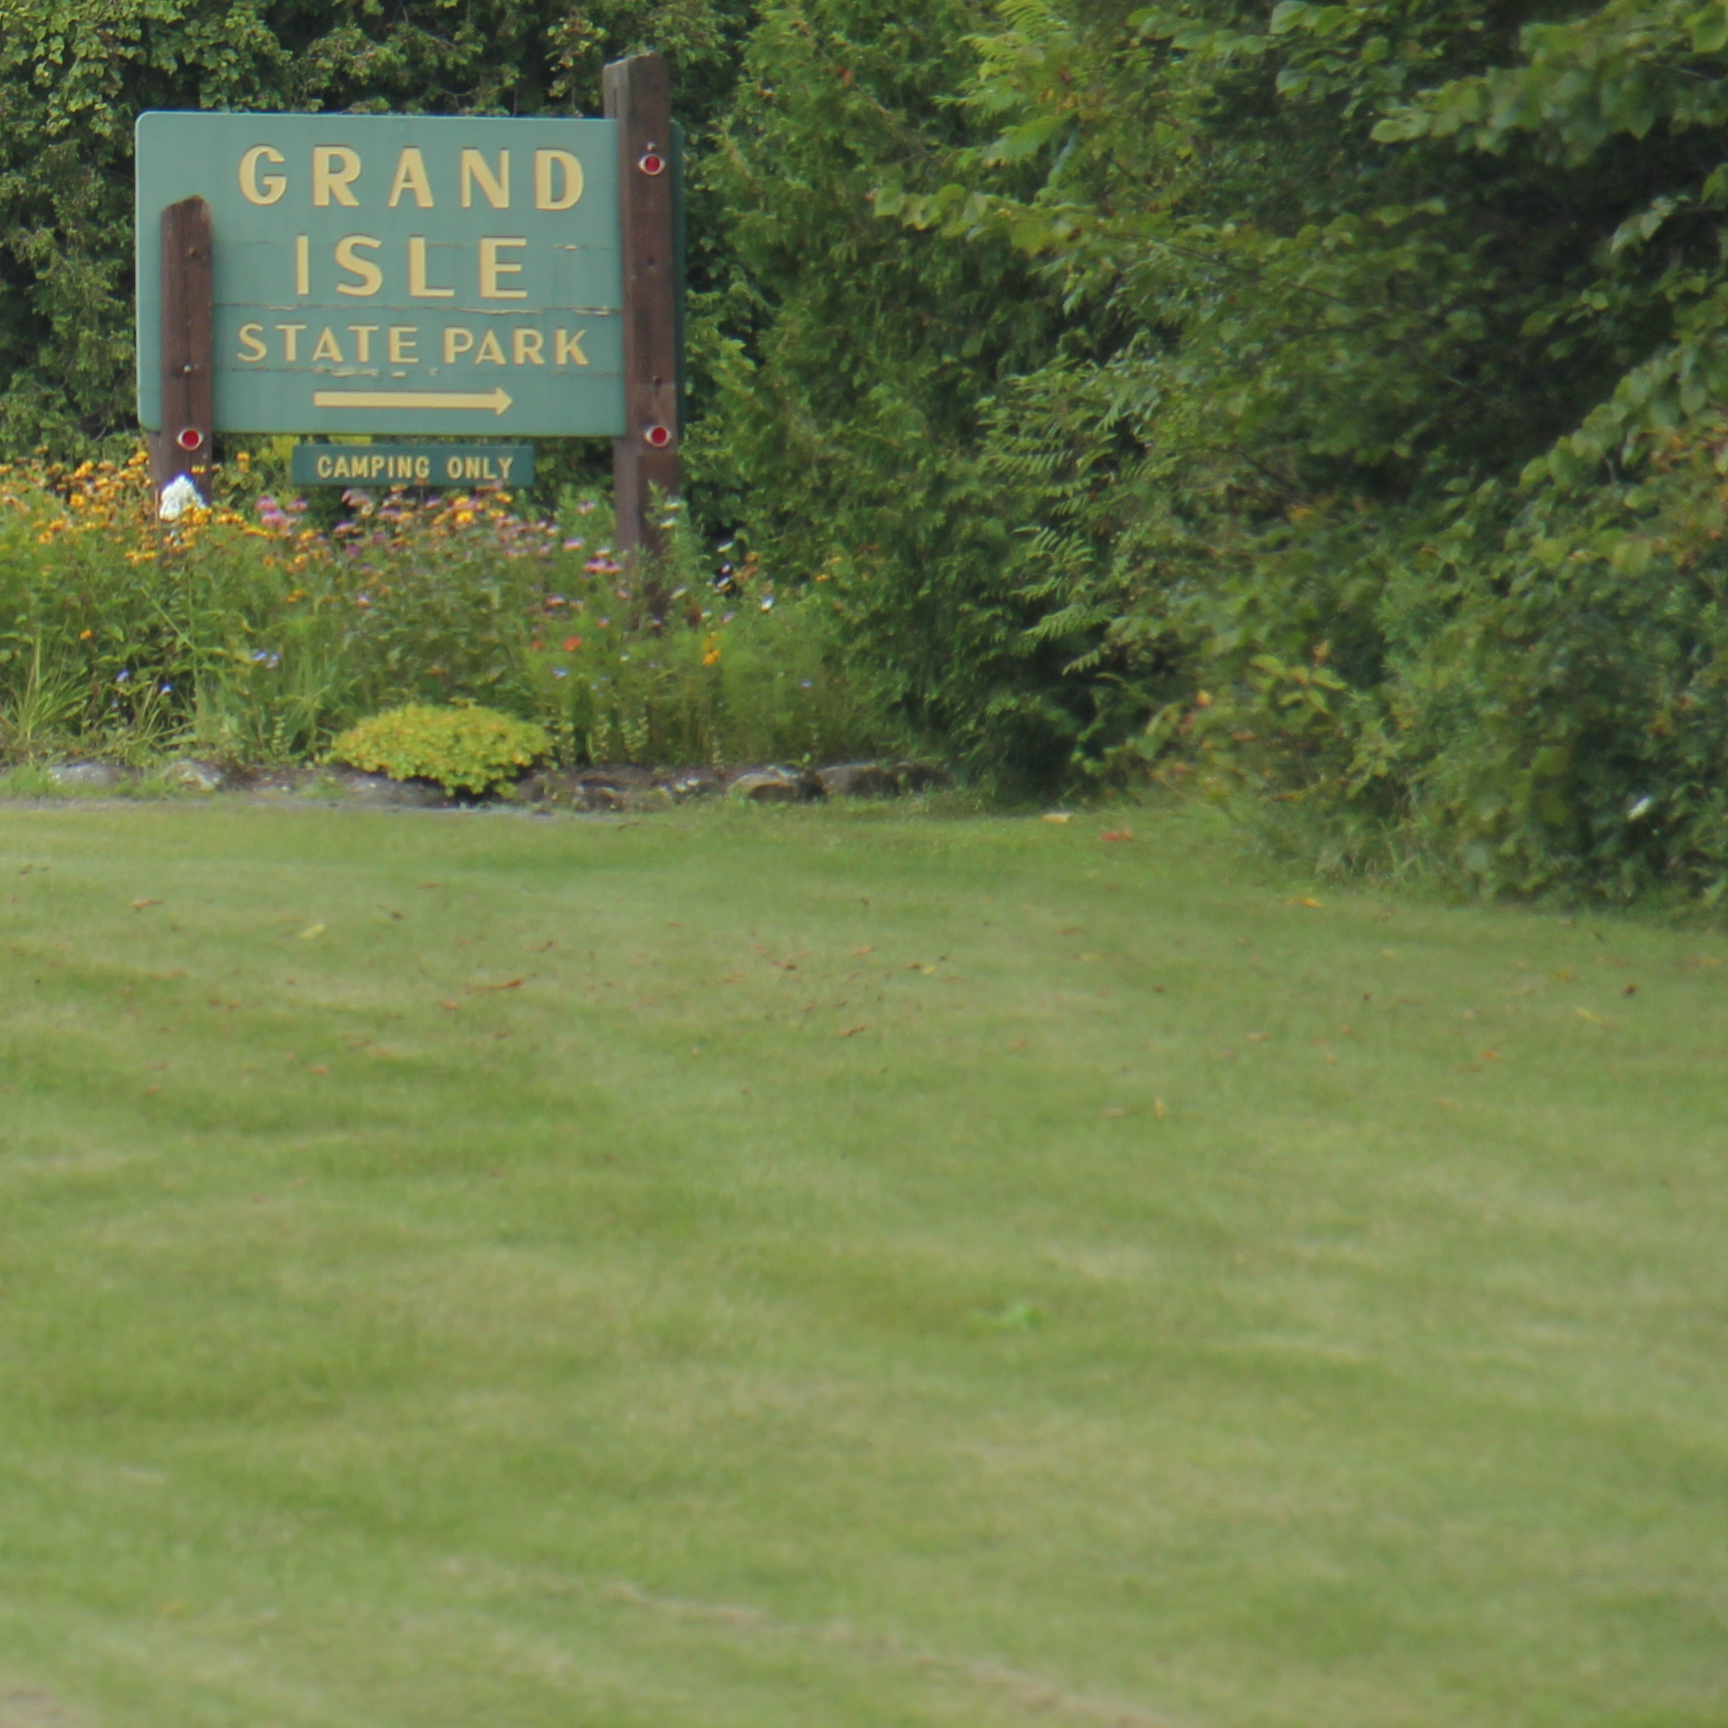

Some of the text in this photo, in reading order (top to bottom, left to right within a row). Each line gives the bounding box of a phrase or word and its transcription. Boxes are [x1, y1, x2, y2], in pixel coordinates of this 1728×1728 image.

[238, 144, 584, 211] GRAND
[295, 234, 527, 299] ISLE
[237, 323, 589, 365] STATE PARK
[317, 455, 514, 479] CAMPING ONLY
